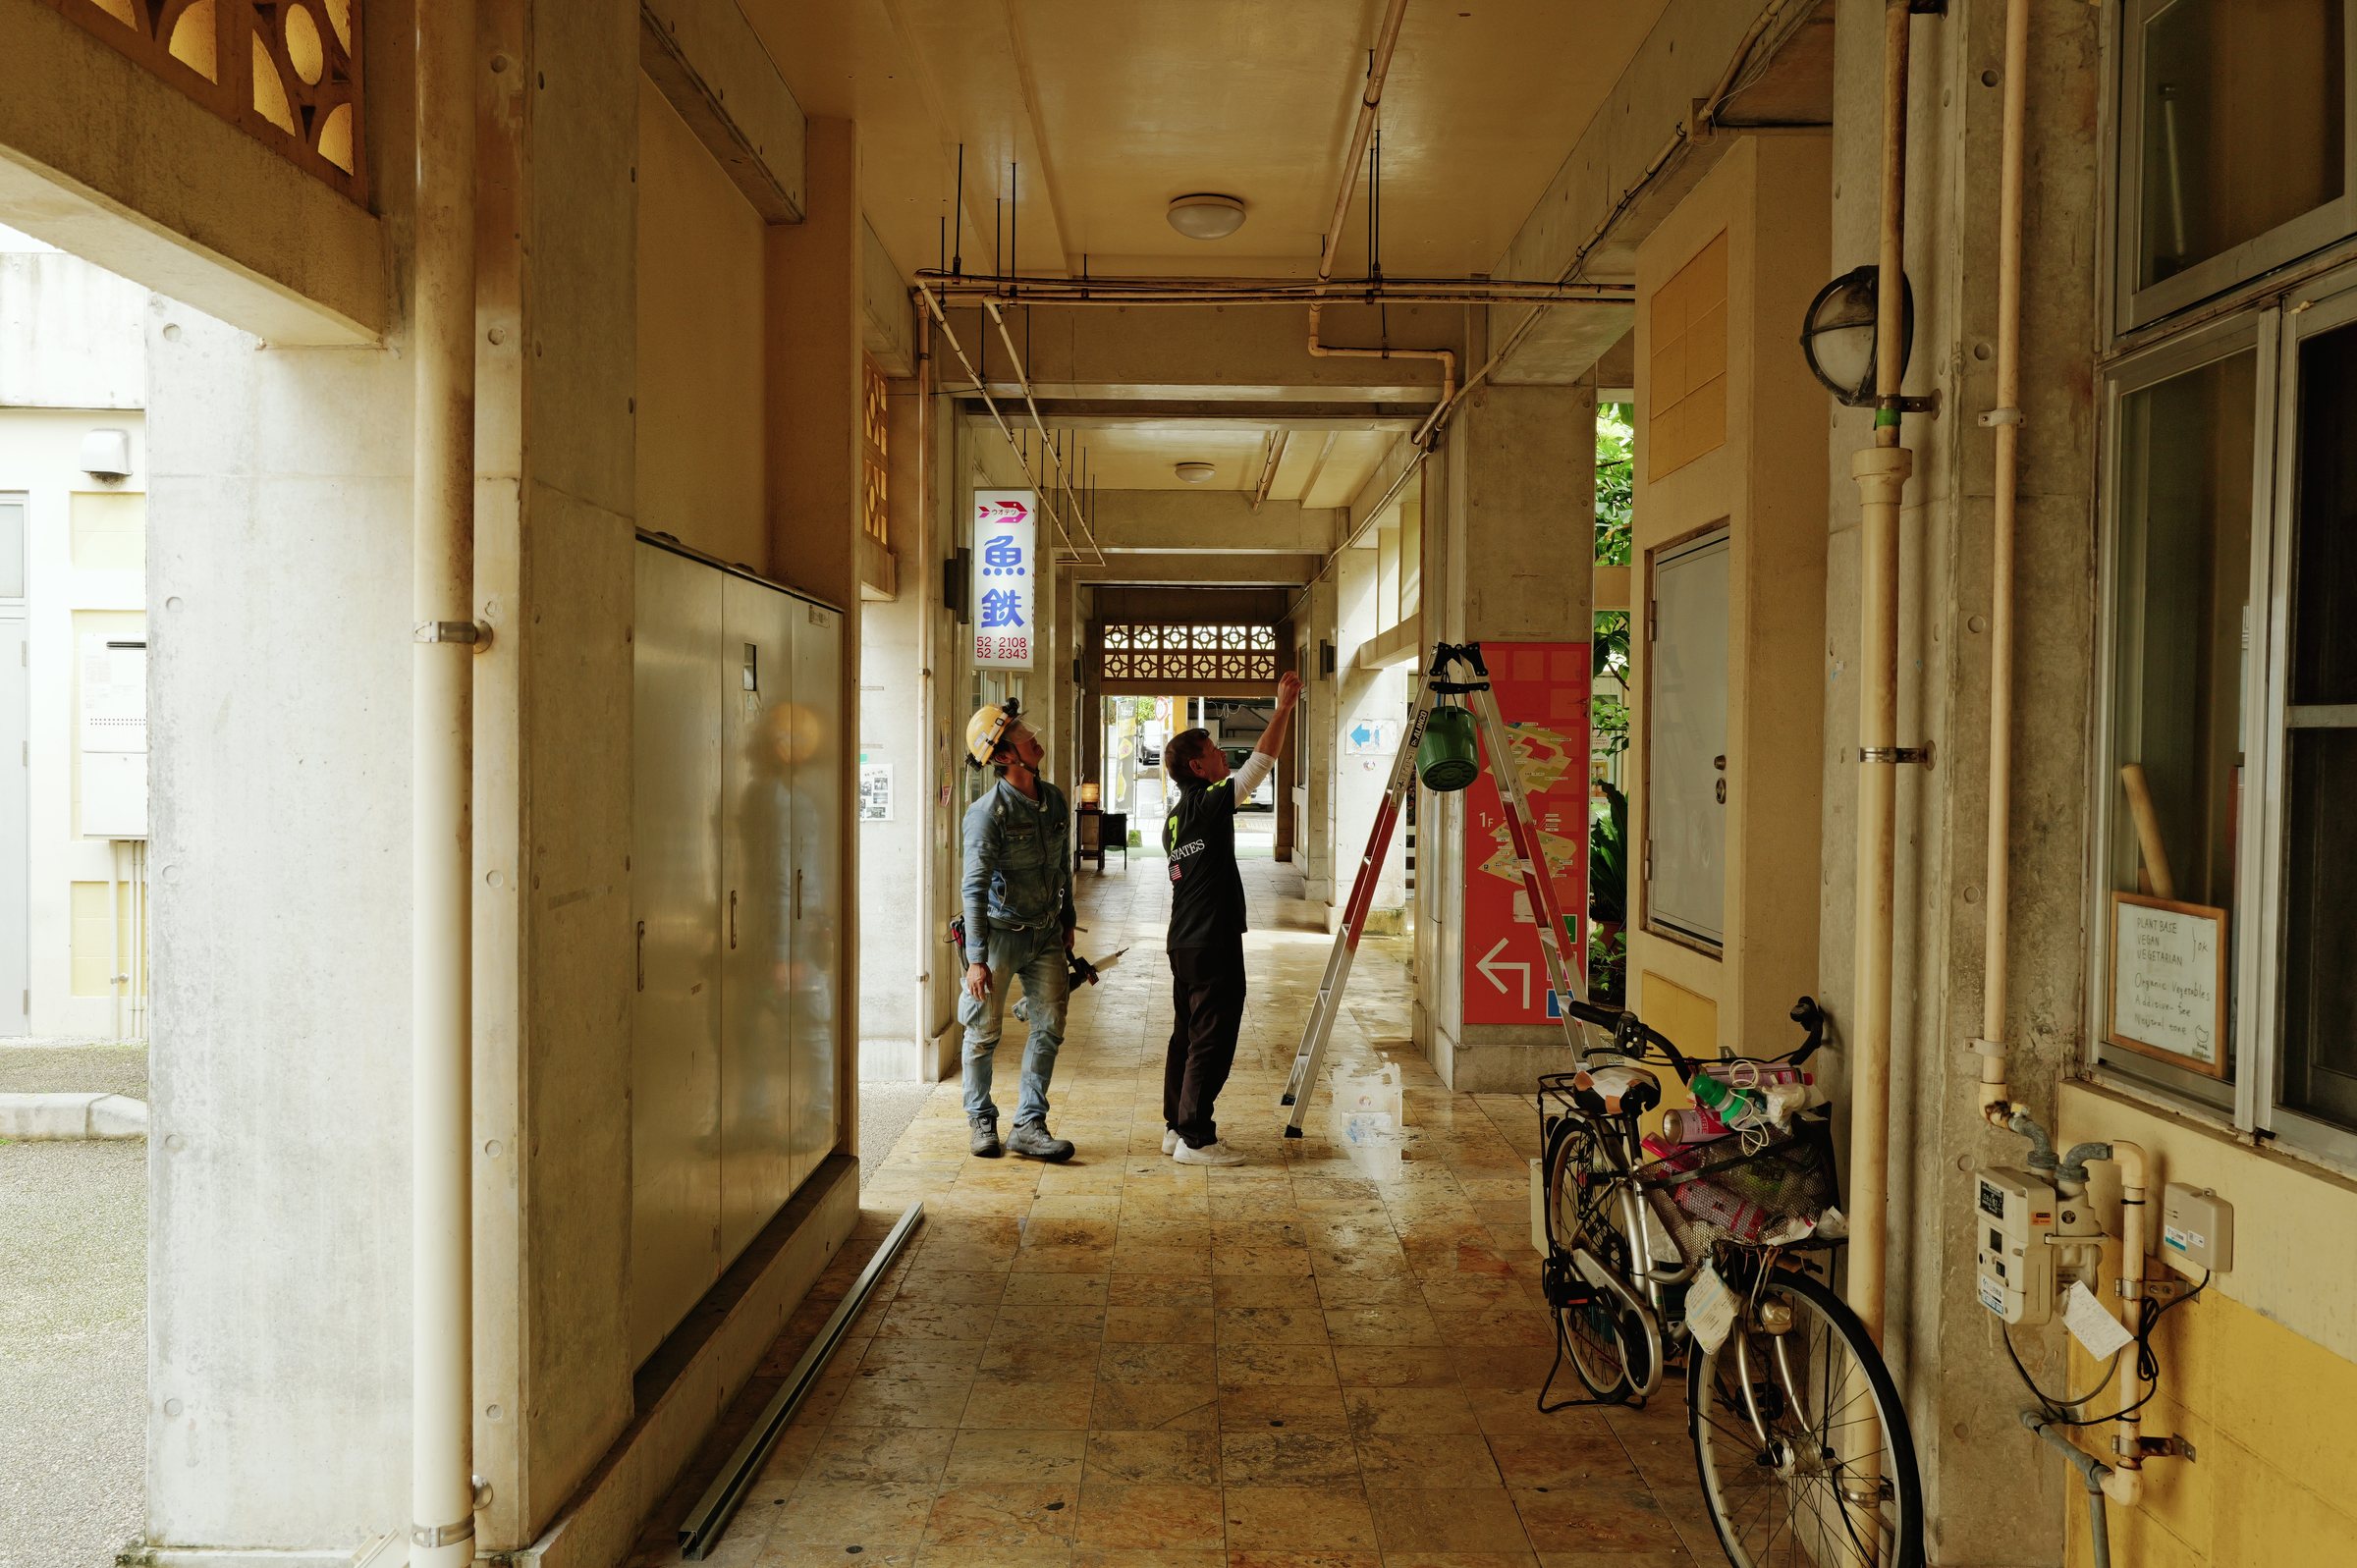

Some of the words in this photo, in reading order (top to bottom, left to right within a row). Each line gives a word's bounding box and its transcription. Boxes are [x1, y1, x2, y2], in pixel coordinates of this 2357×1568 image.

[980, 535, 1025, 628] 魚鉄
[1414, 711, 1428, 739] ALINCO
[1479, 812, 1494, 828] 1F
[1171, 838, 1205, 862] STATES
[2137, 917, 2159, 931] PLANT
[2160, 920, 2177, 934] BASE
[2137, 934, 2160, 946] VEGAN
[2137, 948, 2183, 966] VEGETARIAN
[2135, 972, 2167, 992] Organic
[2171, 981, 2210, 1001] Vegetables
